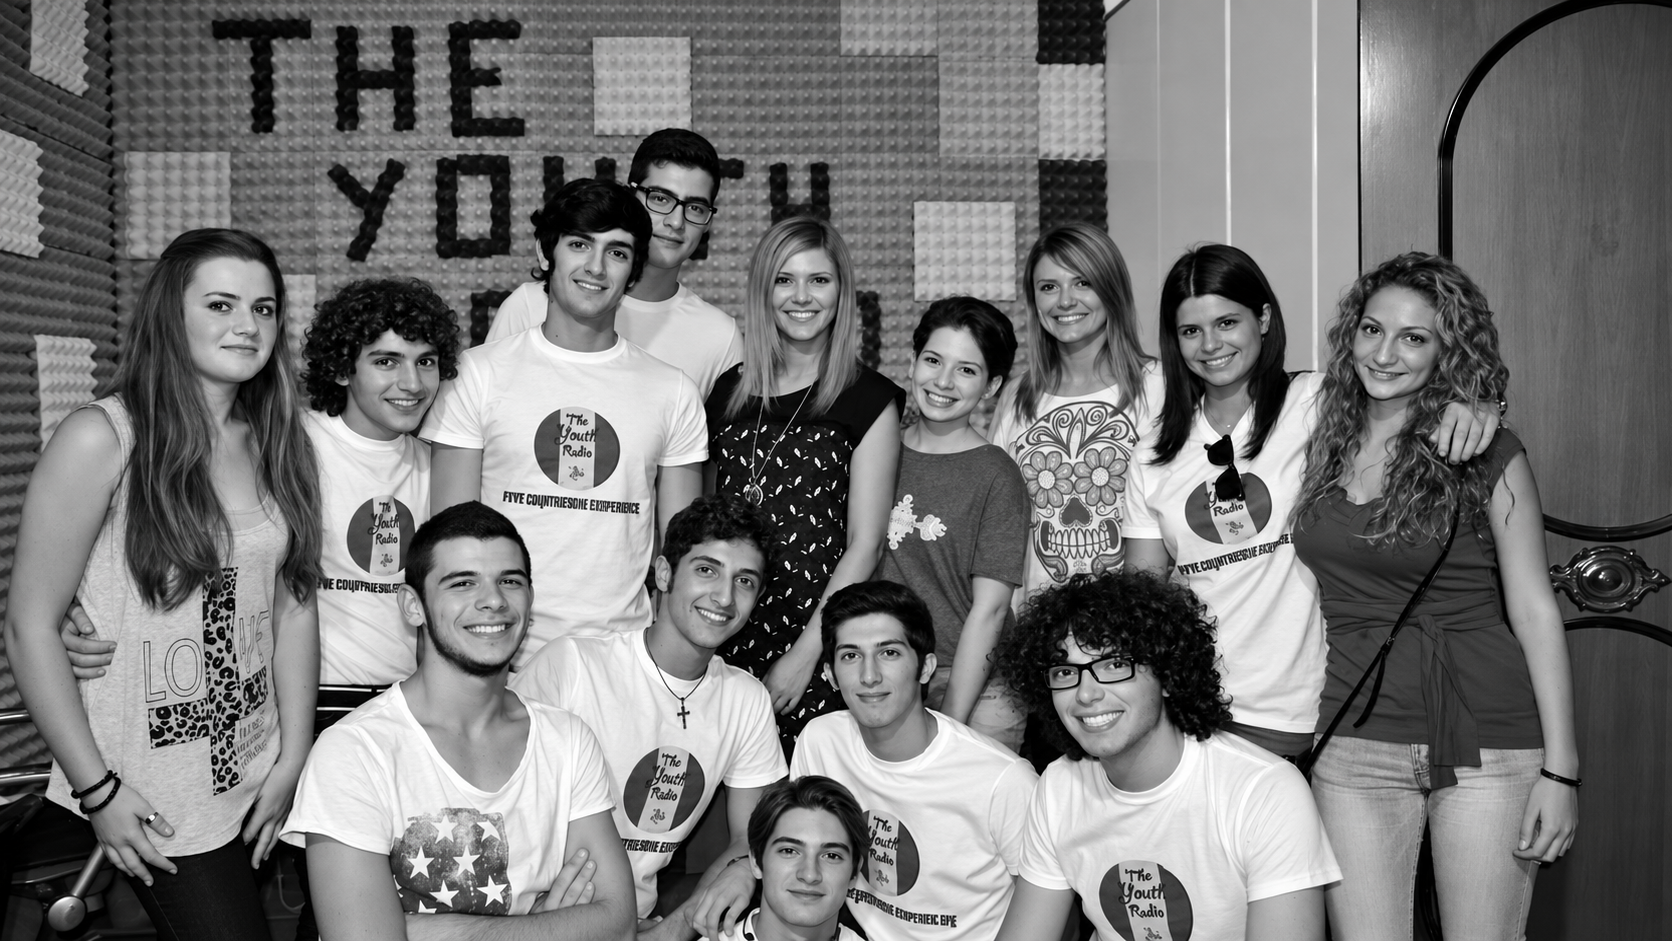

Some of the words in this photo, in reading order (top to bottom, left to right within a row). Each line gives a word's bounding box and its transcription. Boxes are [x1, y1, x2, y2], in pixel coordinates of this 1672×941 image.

[212, 19, 525, 137] THE
[566, 413, 588, 426] The
[554, 424, 599, 445] Youth
[562, 445, 592, 458] Radio
[1213, 502, 1244, 516] Radio
[367, 513, 400, 535] Youth
[375, 532, 398, 545] Radio
[662, 753, 681, 767] The
[645, 765, 690, 788] Youth
[651, 787, 677, 801] Radio
[874, 816, 892, 832] The
[869, 848, 894, 866] Radio
[1125, 868, 1152, 881] The
[1118, 881, 1166, 904] Youth
[1128, 903, 1164, 918] Radio
